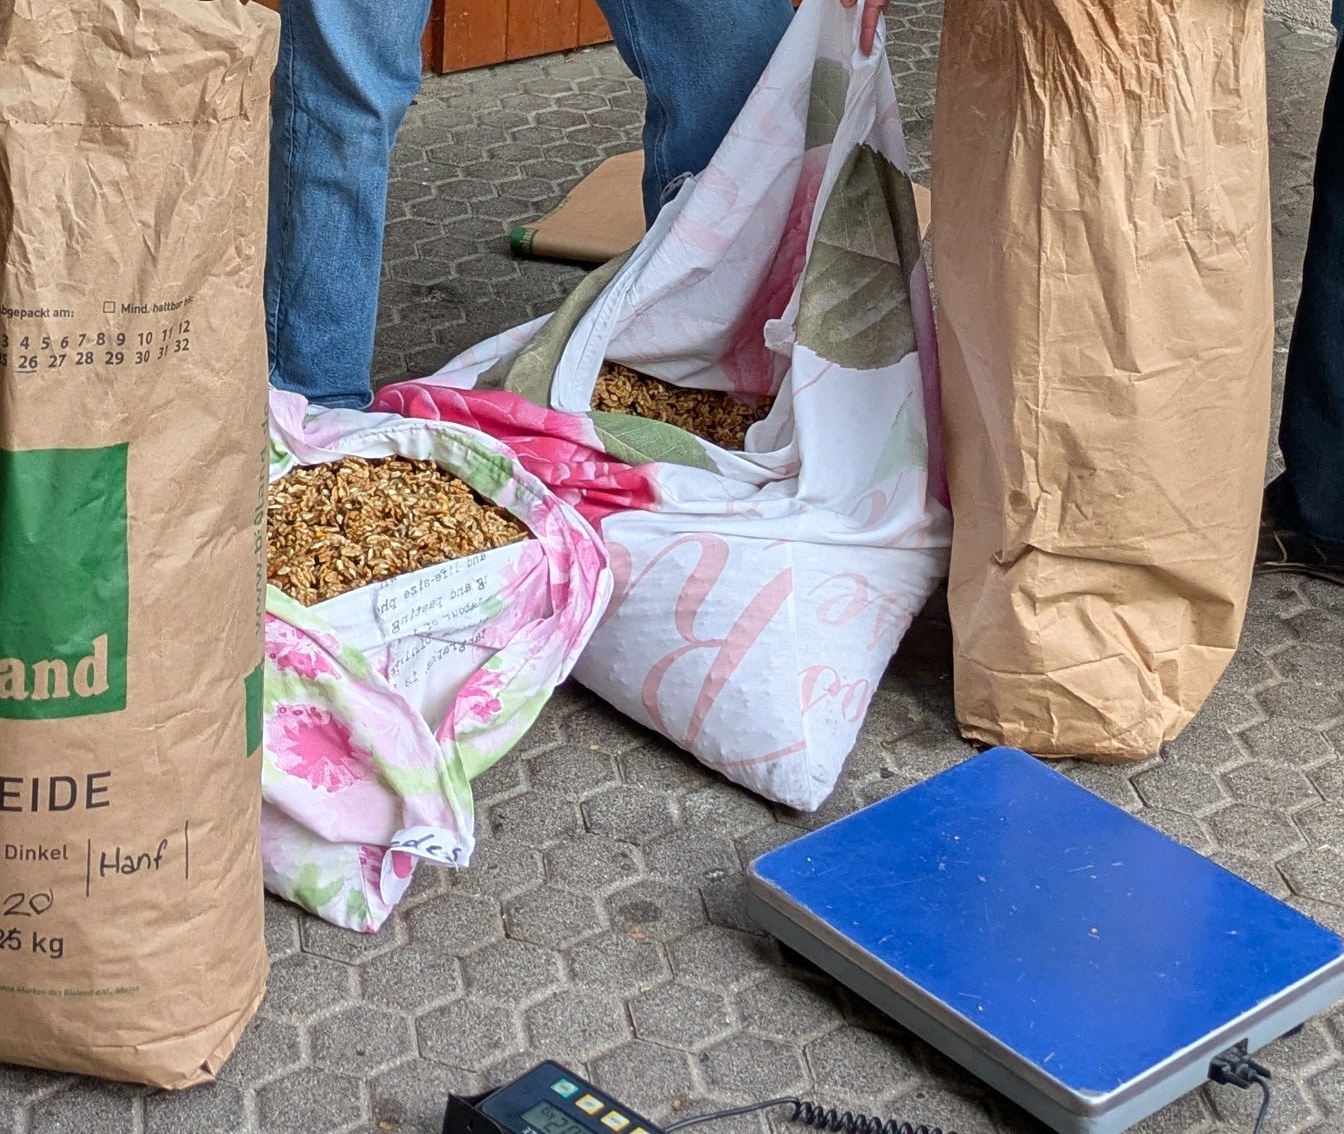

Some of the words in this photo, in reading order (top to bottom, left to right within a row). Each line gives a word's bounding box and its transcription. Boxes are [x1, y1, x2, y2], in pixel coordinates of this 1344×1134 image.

[53, 309, 75, 318] am:
[121, 303, 150, 314] Mind.
[153, 300, 183, 313] haltbar
[2, 334, 9, 348] 3
[19, 336, 30, 350] 4
[40, 336, 50, 350] 5
[60, 335, 69, 349] 6
[78, 333, 87, 347] 7
[96, 332, 106, 346] 8
[116, 332, 126, 346] 9
[137, 331, 153, 346] 10
[178, 320, 191, 335] 12
[18, 355, 38, 369] 26
[48, 354, 67, 368] 27
[75, 351, 94, 365] 28
[104, 351, 125, 365] 29
[135, 350, 151, 365] 30
[157, 345, 169, 360] 31
[174, 338, 190, 353] 32
[4, 843, 69, 862] Dinkel
[99, 838, 168, 878] Hanf
[2, 888, 55, 917] 20
[32, 931, 65, 959] kg
